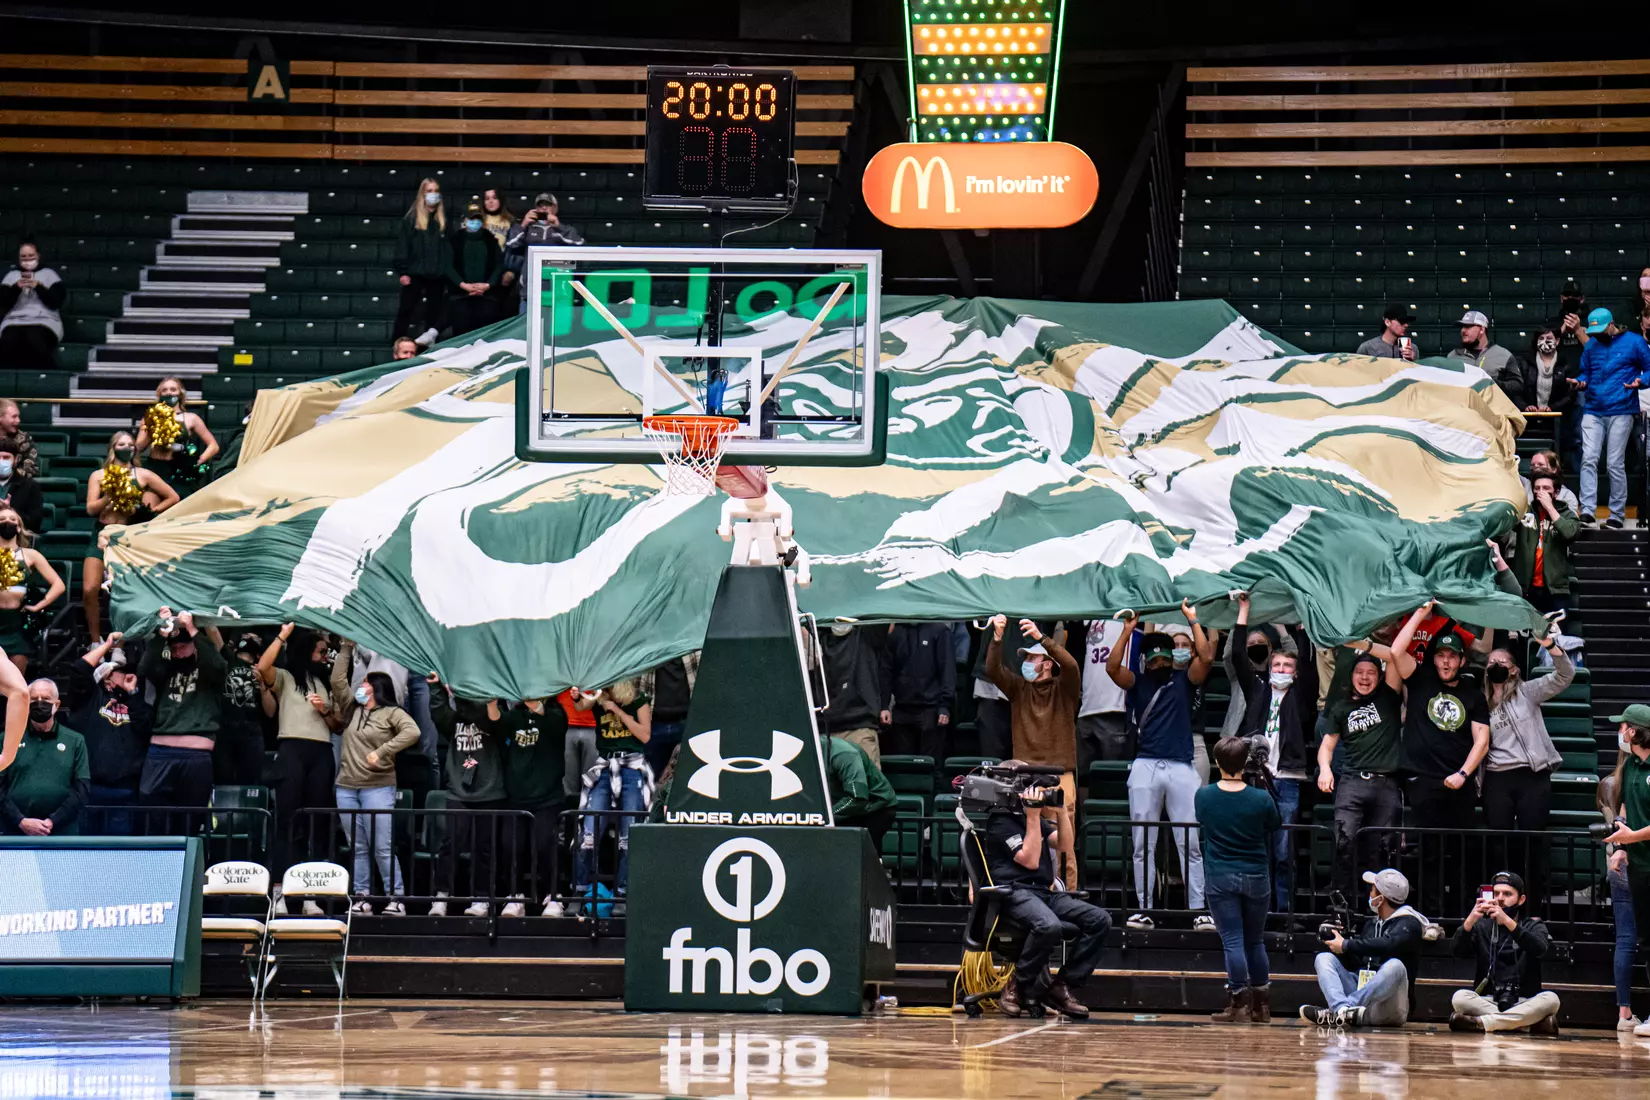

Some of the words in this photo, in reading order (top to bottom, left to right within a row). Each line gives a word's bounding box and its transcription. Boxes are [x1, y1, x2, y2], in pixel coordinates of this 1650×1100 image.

[252, 65, 285, 98] A
[663, 82, 776, 120] 20:00
[966, 175, 994, 193] i'm
[997, 175, 1048, 193] lovin'
[1091, 646, 1111, 664] 32
[1495, 720, 1512, 731] STA
[666, 811, 733, 824] UNDER
[738, 812, 826, 825] ARMOUR
[211, 866, 263, 876] Colorado
[290, 869, 342, 879] Colorado
[223, 874, 250, 885] State
[302, 877, 329, 888] State
[662, 927, 831, 996] fnbo
